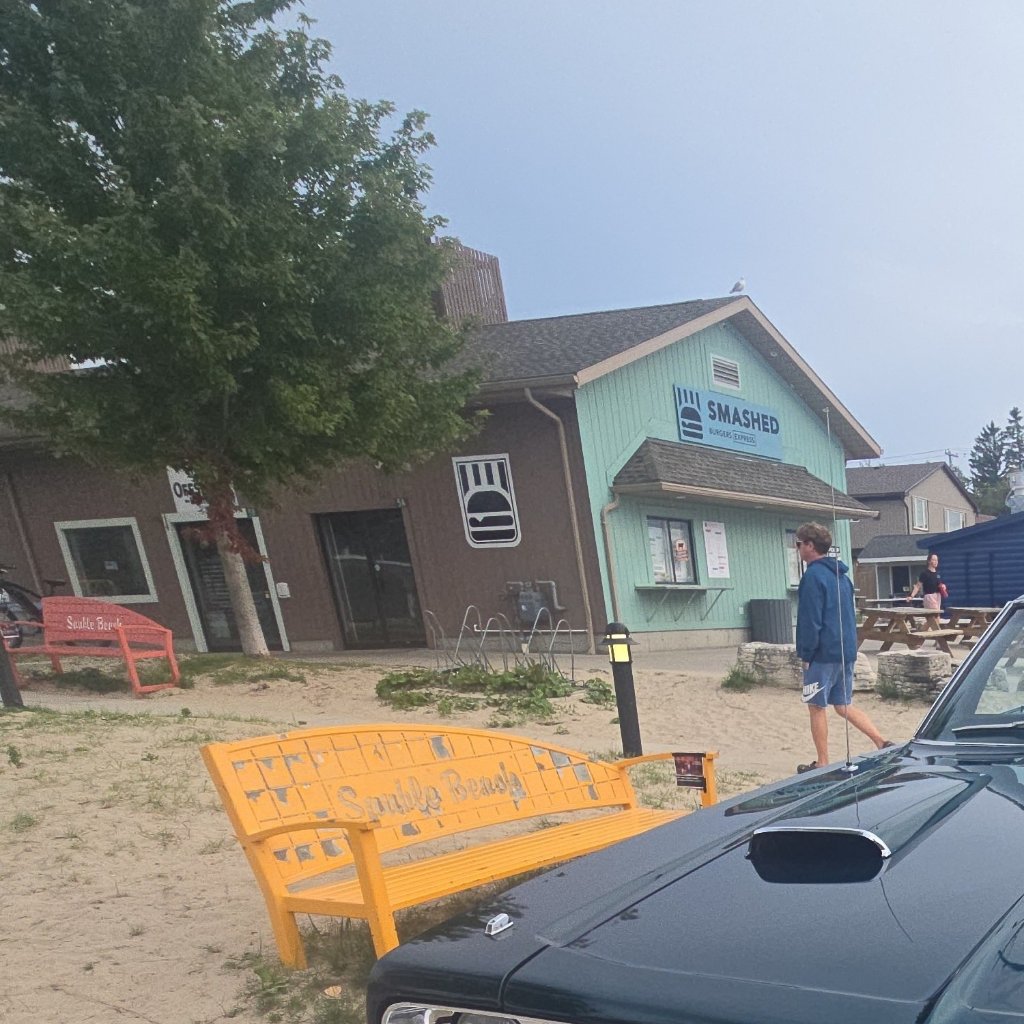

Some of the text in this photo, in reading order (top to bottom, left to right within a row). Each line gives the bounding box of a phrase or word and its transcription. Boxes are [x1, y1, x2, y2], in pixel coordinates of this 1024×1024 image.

[707, 399, 780, 435] SMASHED
[709, 427, 756, 445] BURGERS EXPRESS
[336, 761, 526, 820] Sauble Beach
